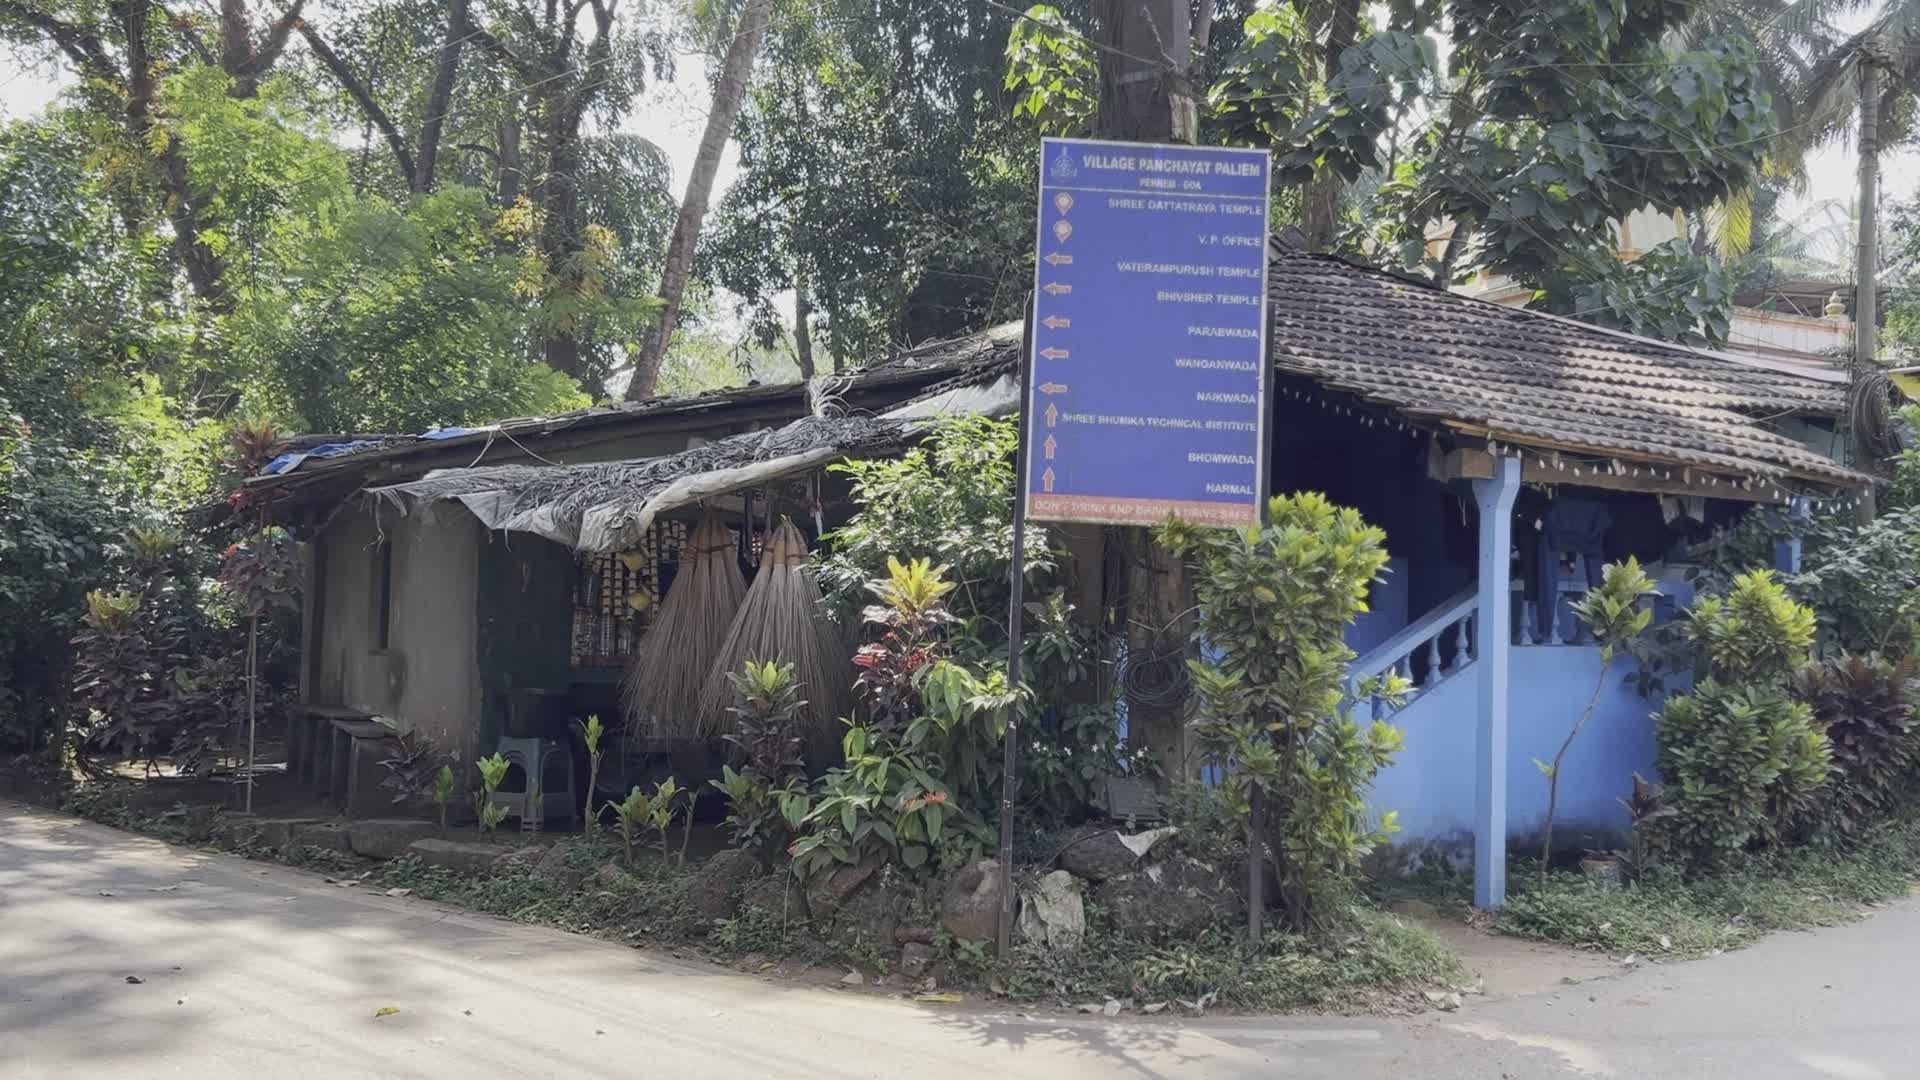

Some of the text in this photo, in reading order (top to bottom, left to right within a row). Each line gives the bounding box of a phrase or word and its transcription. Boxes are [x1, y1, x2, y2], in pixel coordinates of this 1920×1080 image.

[1083, 155, 1261, 177] VILLAGE PANCHAYAT PALIEM
[1183, 180, 1202, 190] GOA
[1108, 198, 1263, 215] SHREE DATTATRAYA TEMPLE
[1222, 236, 1262, 247] OFFICE
[1117, 262, 1261, 278] VATERAMPURUSH TEMPLE
[1157, 291, 1260, 306] BHIVSHER TEMPLE
[1188, 326, 1259, 339] PARABWADA
[1175, 358, 1258, 372] WANGANWADA
[1197, 391, 1257, 404] NAIKWADA
[1062, 413, 1096, 424] SHREE
[1147, 417, 1202, 430] TECHNICAL
[1206, 420, 1257, 432] INSTITUTE
[1188, 452, 1256, 465] BHOMWADA
